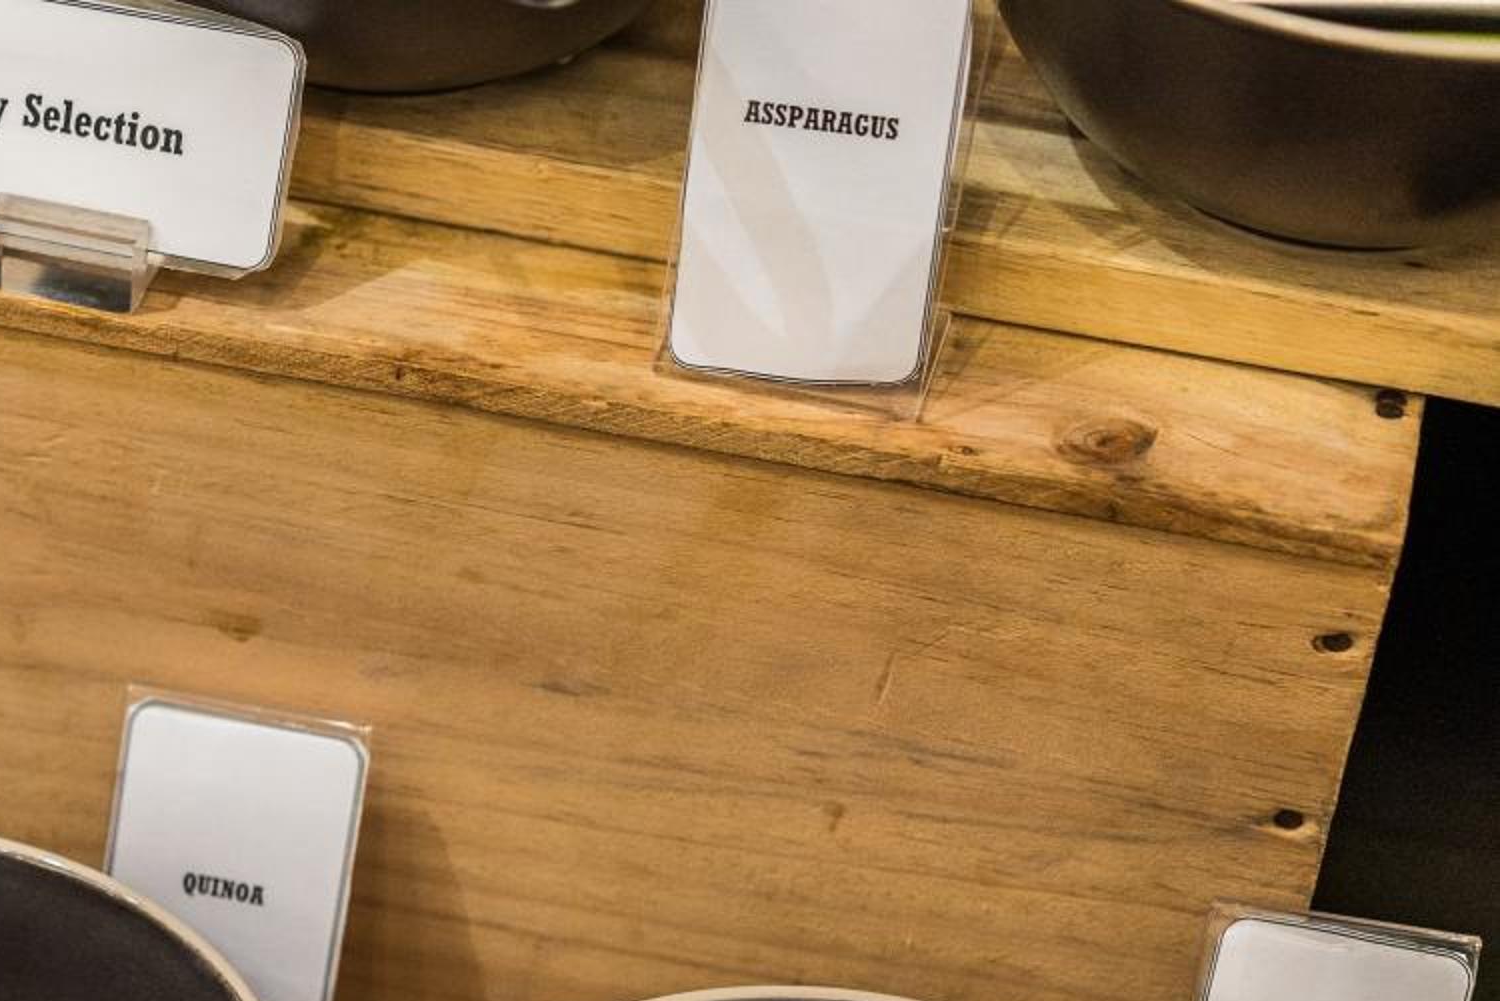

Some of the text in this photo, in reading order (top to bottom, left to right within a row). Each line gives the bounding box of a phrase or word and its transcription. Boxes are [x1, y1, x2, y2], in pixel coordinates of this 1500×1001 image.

[23, 93, 183, 156] Selection
[743, 100, 899, 140] ASSPARAGUS
[182, 872, 264, 907] QUINOA
